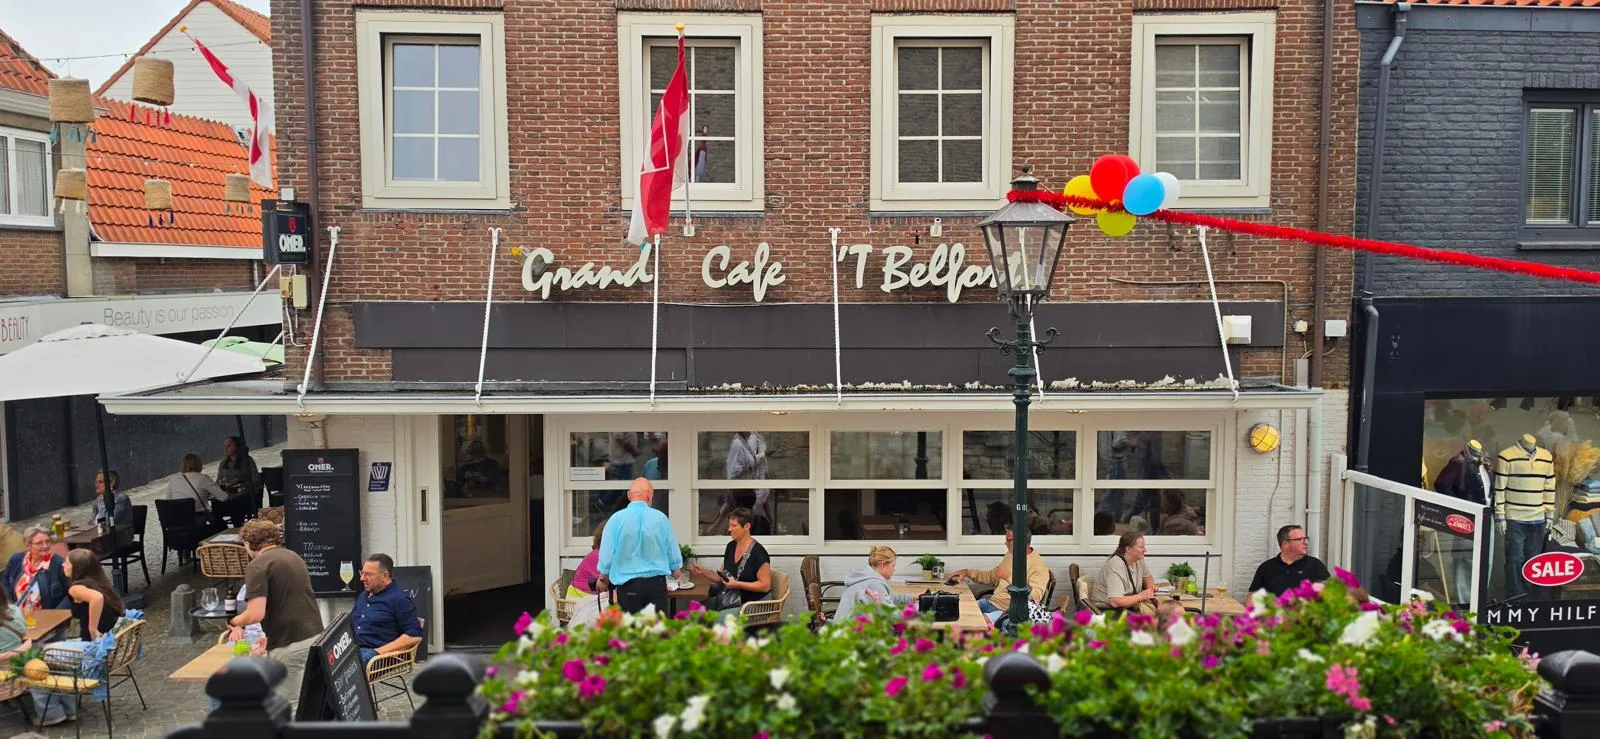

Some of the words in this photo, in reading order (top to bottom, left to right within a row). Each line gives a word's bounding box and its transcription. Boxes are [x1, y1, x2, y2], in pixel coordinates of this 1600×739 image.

[521, 242, 654, 301] Grand
[702, 242, 786, 302] Cafe
[103, 307, 152, 328] Beauty
[155, 309, 166, 323] is
[168, 307, 188, 322] our
[191, 304, 234, 325] passion
[1531, 560, 1574, 578] SALE
[1550, 606, 1596, 621] HILF
